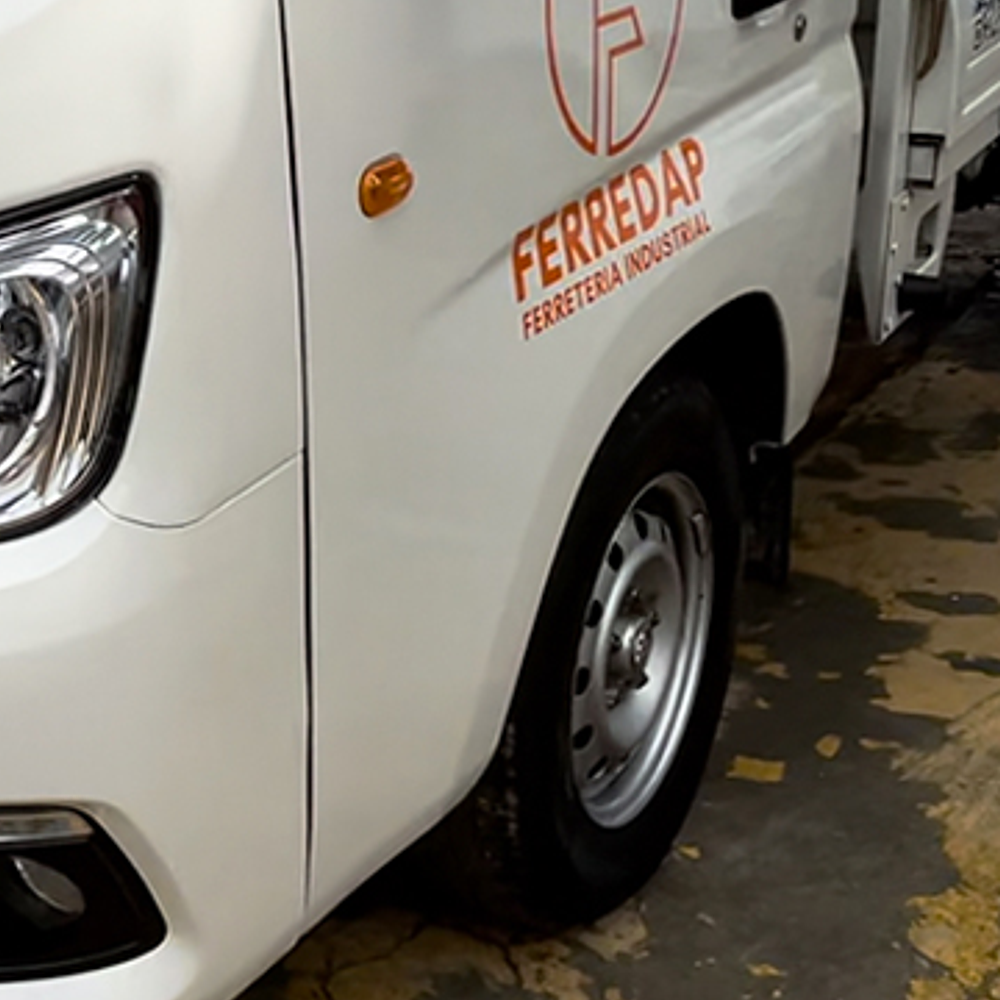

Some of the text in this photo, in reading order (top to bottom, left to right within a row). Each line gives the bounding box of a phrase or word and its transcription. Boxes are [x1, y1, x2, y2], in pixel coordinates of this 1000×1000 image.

[511, 136, 705, 303] FERREDAP
[521, 210, 712, 341] FERRETERIA INDUSTRIAL
